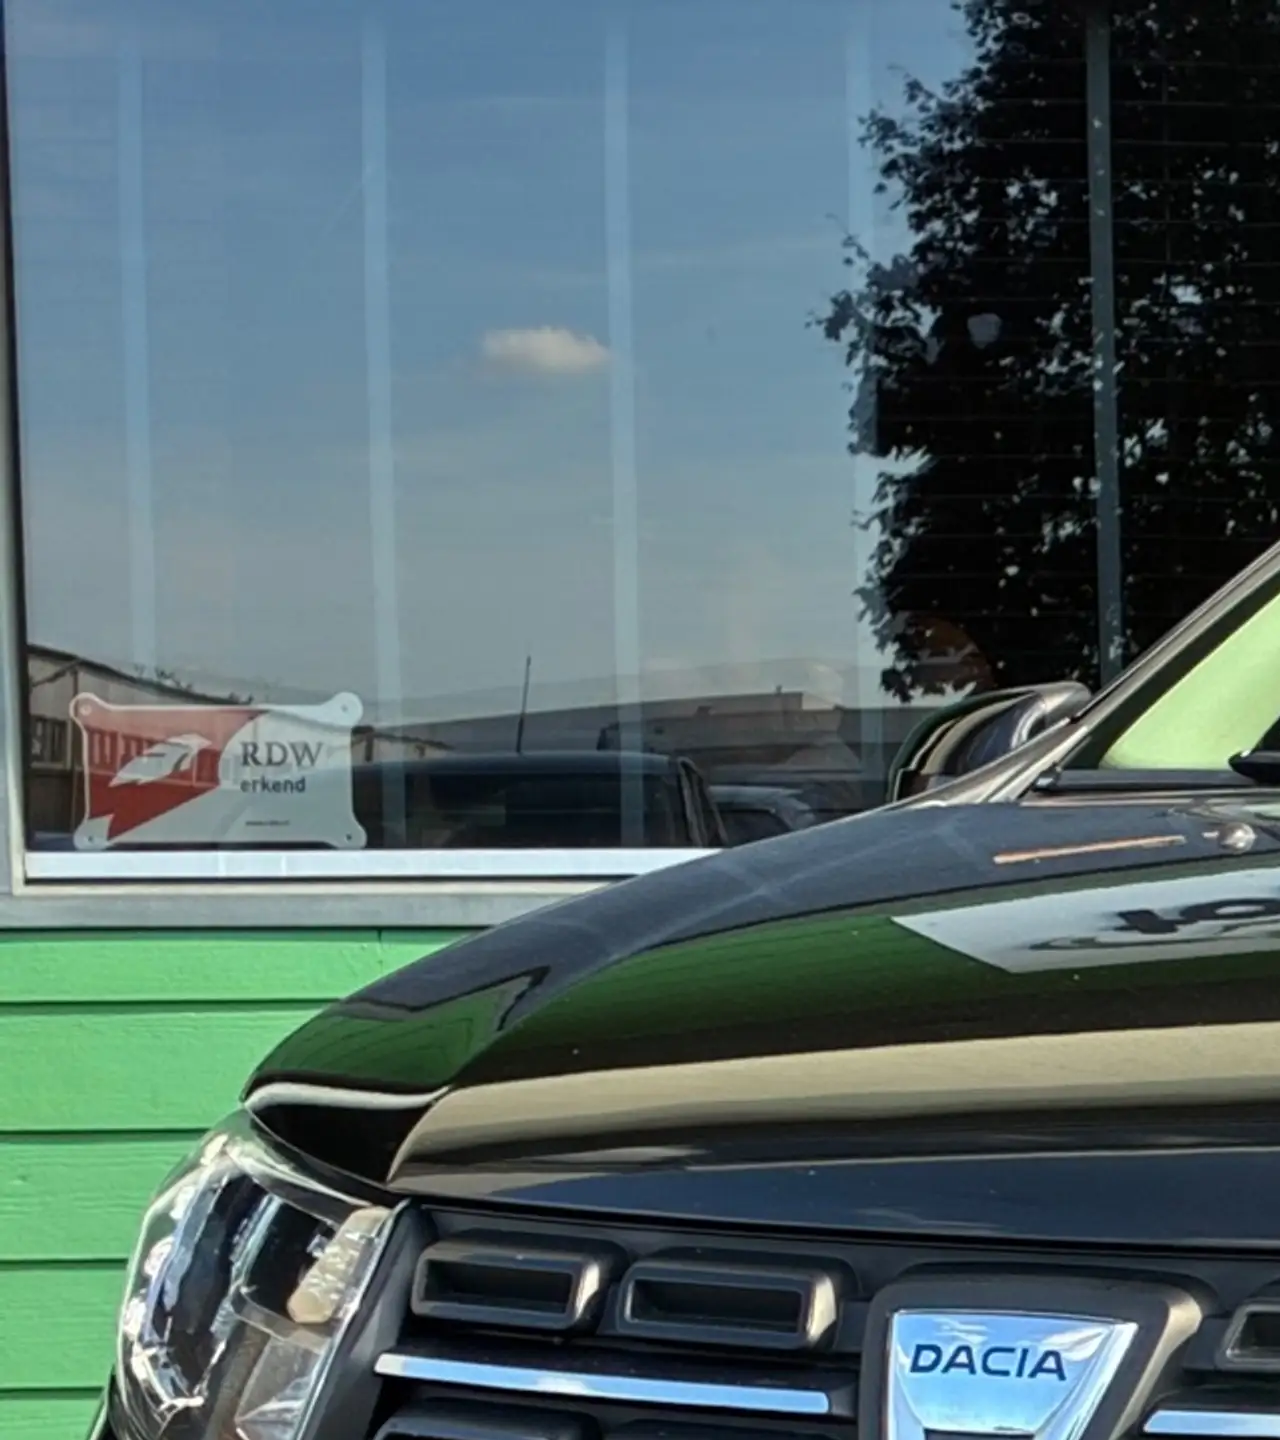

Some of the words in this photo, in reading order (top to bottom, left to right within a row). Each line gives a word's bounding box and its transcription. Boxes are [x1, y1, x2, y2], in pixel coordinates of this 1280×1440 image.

[240, 741, 325, 768] RDW
[239, 776, 307, 793] erkend
[908, 1343, 1068, 1381] DACIA
